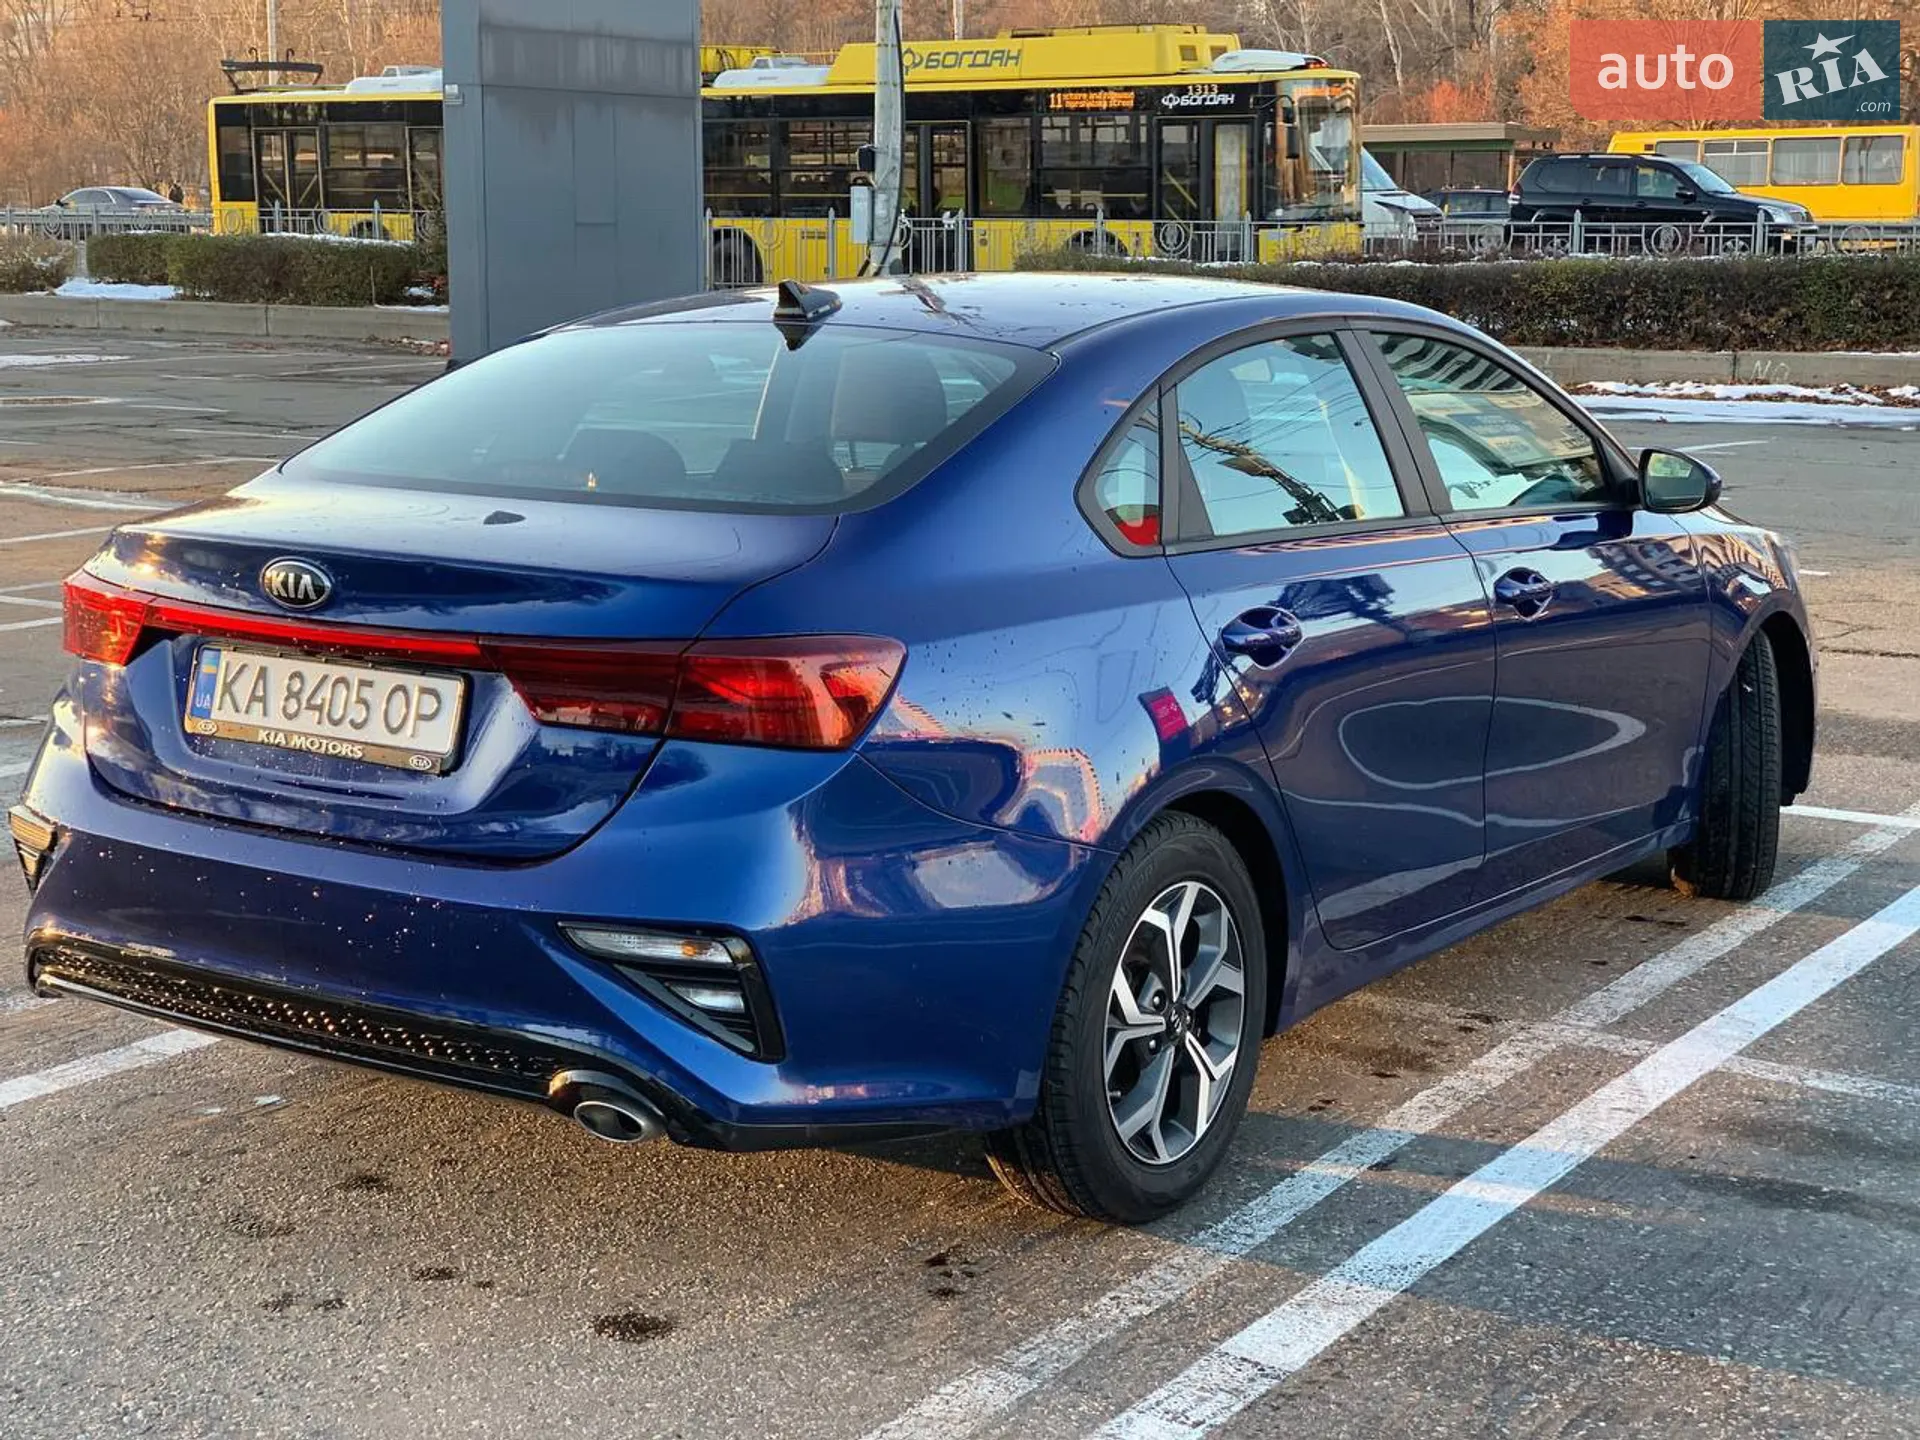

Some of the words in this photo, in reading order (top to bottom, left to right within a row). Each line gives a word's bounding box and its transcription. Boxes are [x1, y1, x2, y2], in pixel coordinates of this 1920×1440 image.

[924, 49, 1022, 70] БОГДАН
[1187, 84, 1219, 95] 1313
[1049, 93, 1063, 108] 11
[1180, 94, 1235, 105] БОГДАН
[271, 569, 318, 600] KIA
[195, 694, 212, 709] UA
[217, 660, 268, 717] KA
[282, 670, 374, 730] 8405
[382, 682, 443, 739] OP
[257, 729, 286, 745] KIA
[292, 736, 363, 759] MOTORS
